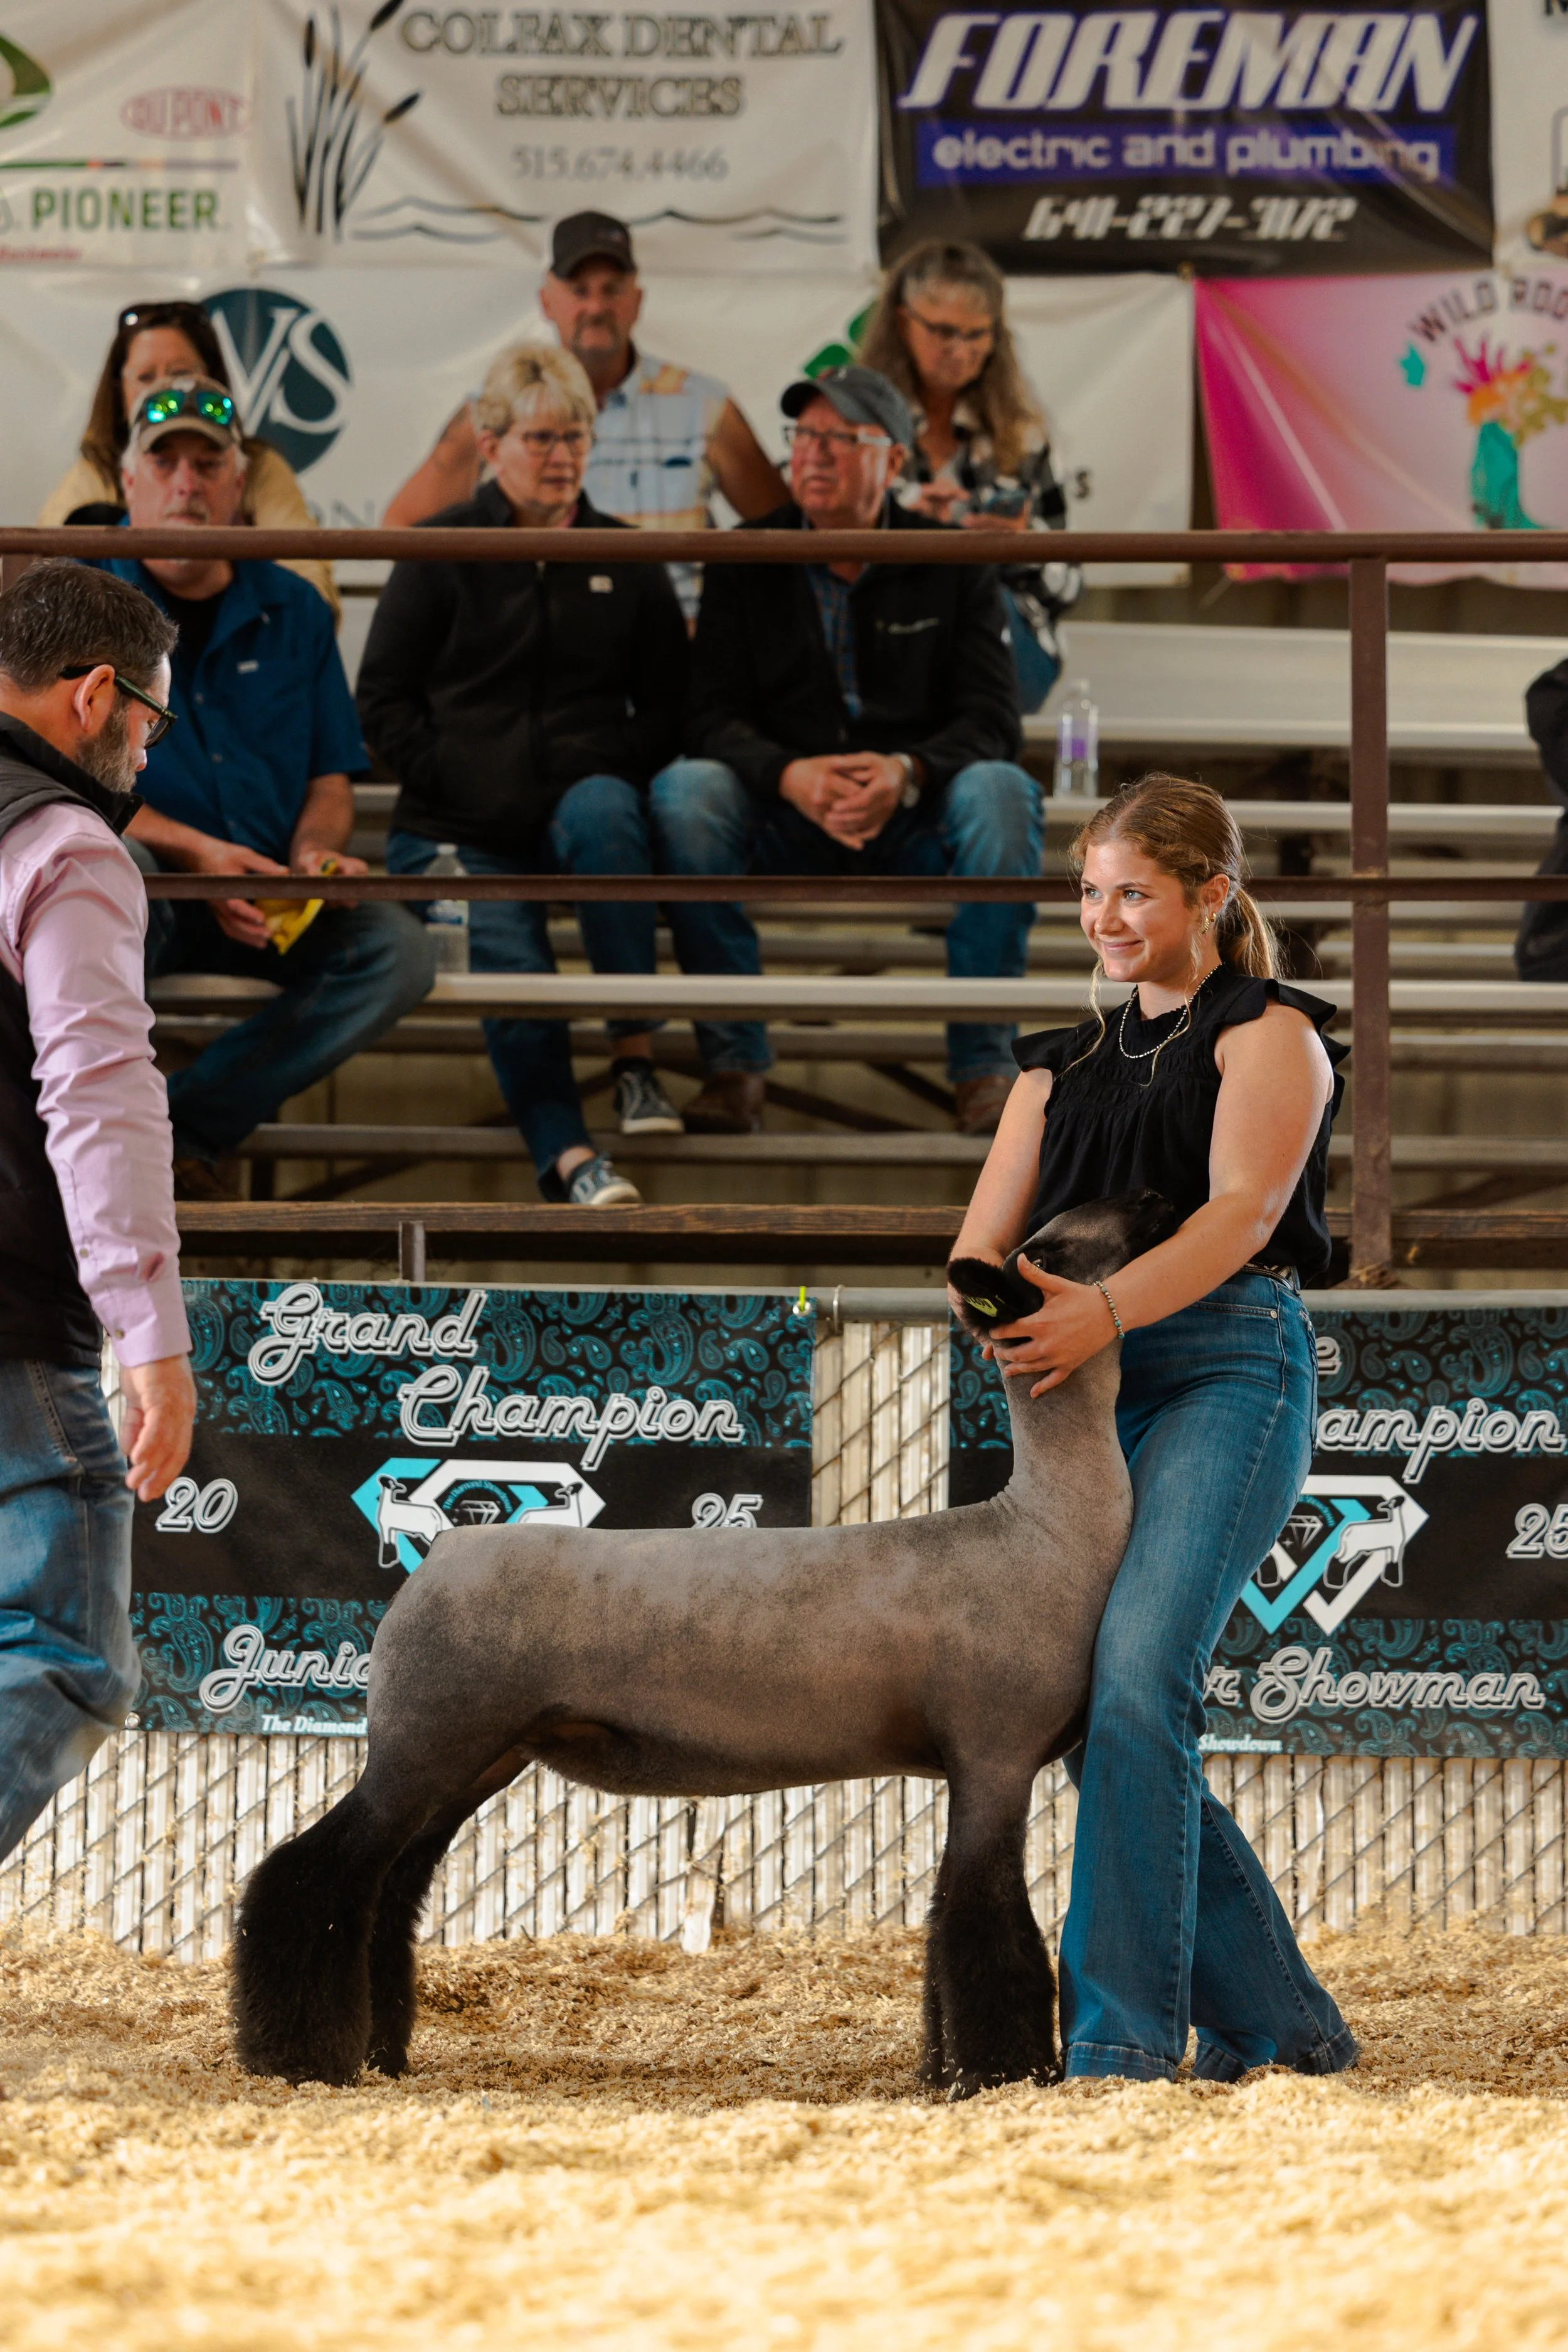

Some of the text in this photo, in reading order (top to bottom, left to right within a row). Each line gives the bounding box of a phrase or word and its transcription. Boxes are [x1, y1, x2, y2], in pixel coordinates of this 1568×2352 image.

[401, 13, 843, 56] COLFAX DENTAL
[898, 11, 1478, 112] FOREMAN
[497, 74, 743, 117] SERVICES
[932, 129, 1439, 183] electric and plumbing
[33, 189, 220, 231] PIONEER
[248, 1283, 487, 1386] Grand
[398, 1365, 745, 1471] Champion
[1316, 1397, 1567, 1484] ampion
[156, 1476, 238, 1534] 20
[1506, 1503, 1568, 1559] 25
[1250, 1646, 1545, 1724] Showman
[262, 1714, 368, 1734] The Diamond
[1198, 1733, 1283, 1752] Showdown
